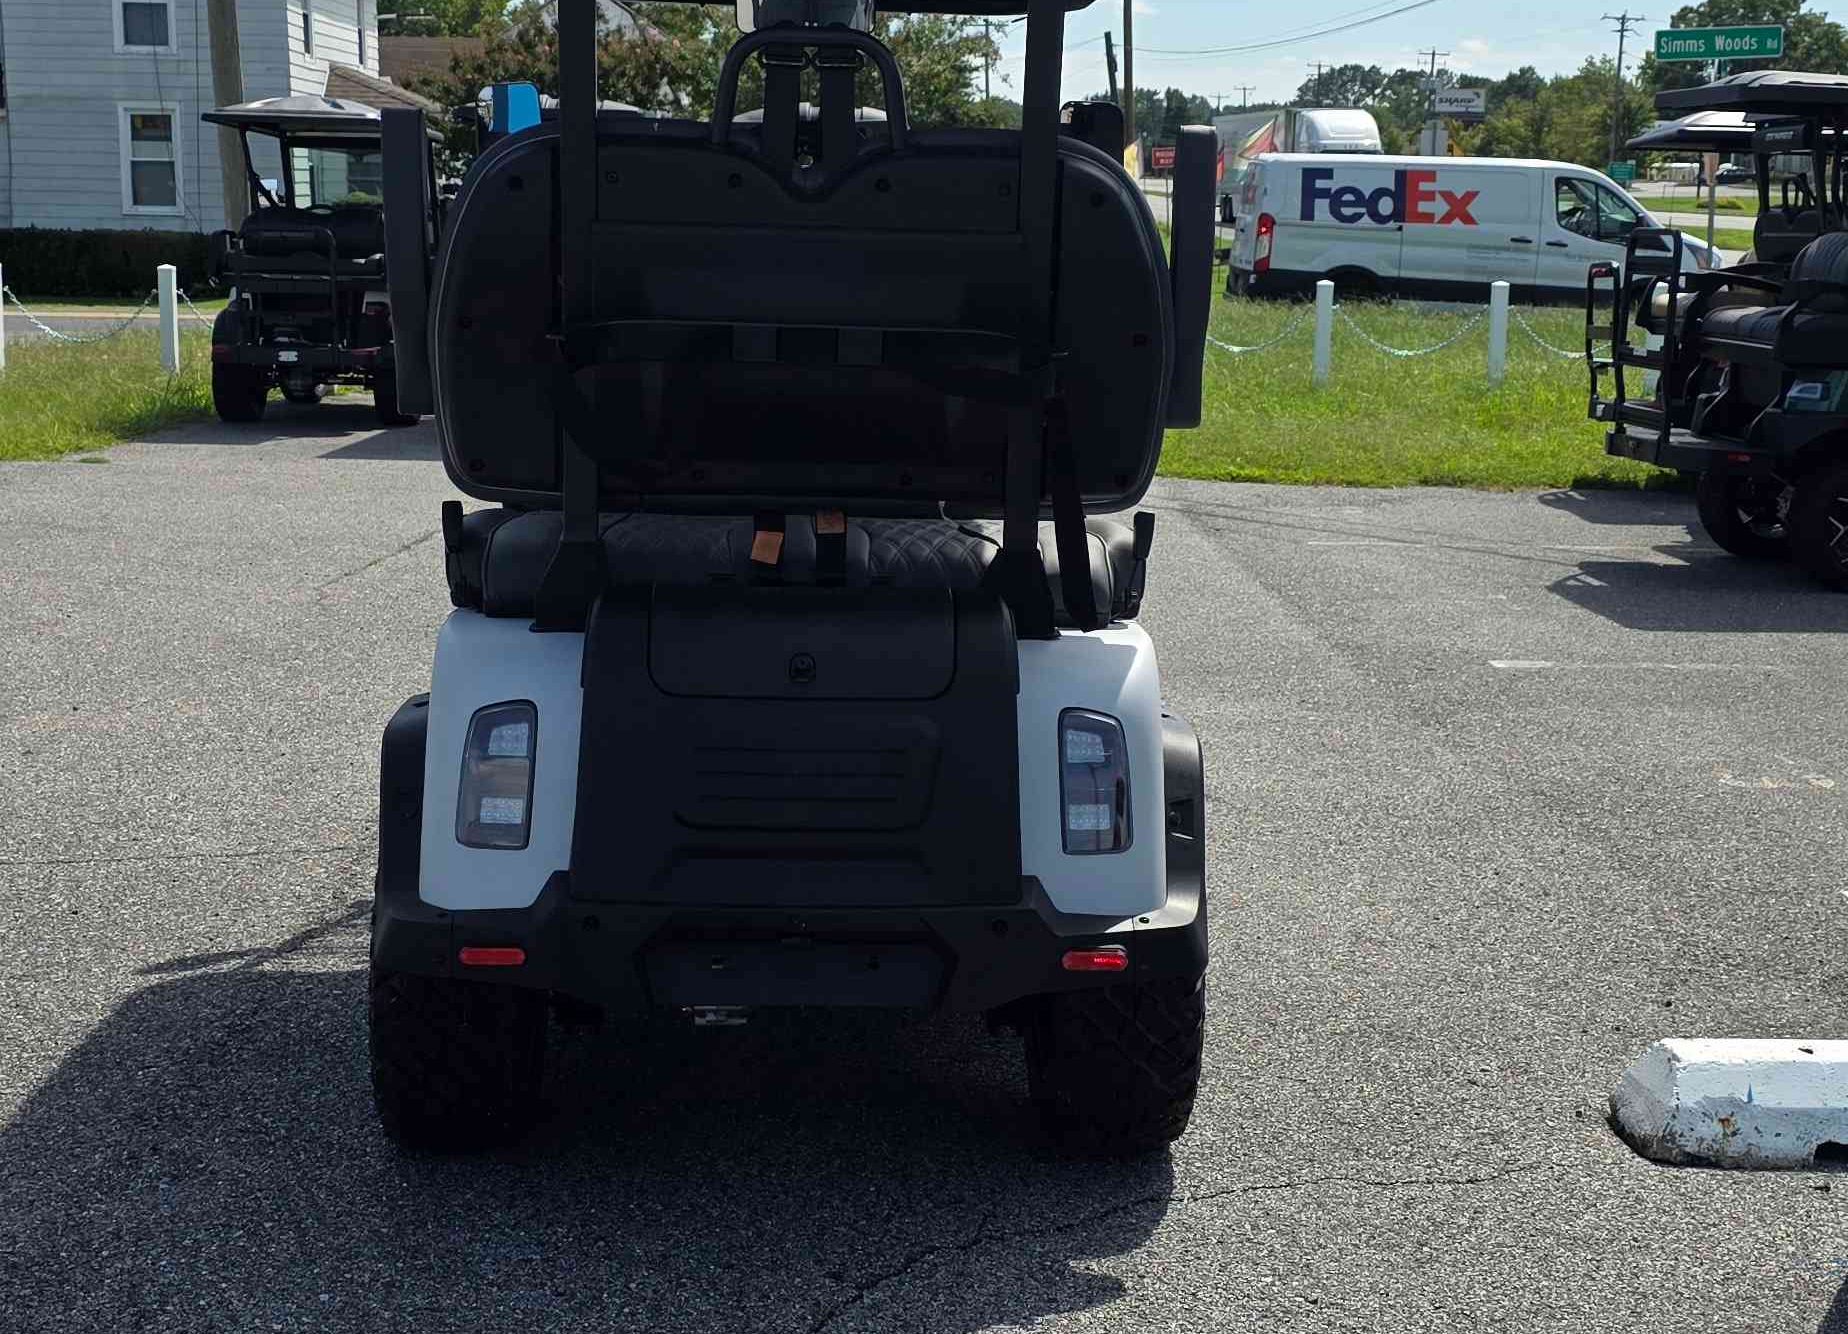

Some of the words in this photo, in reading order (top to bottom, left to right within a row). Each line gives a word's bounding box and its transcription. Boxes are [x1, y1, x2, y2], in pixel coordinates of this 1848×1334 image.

[1660, 37, 1705, 53] Simms
[1714, 35, 1759, 51] Woods
[1300, 167, 1480, 225] FedEx
